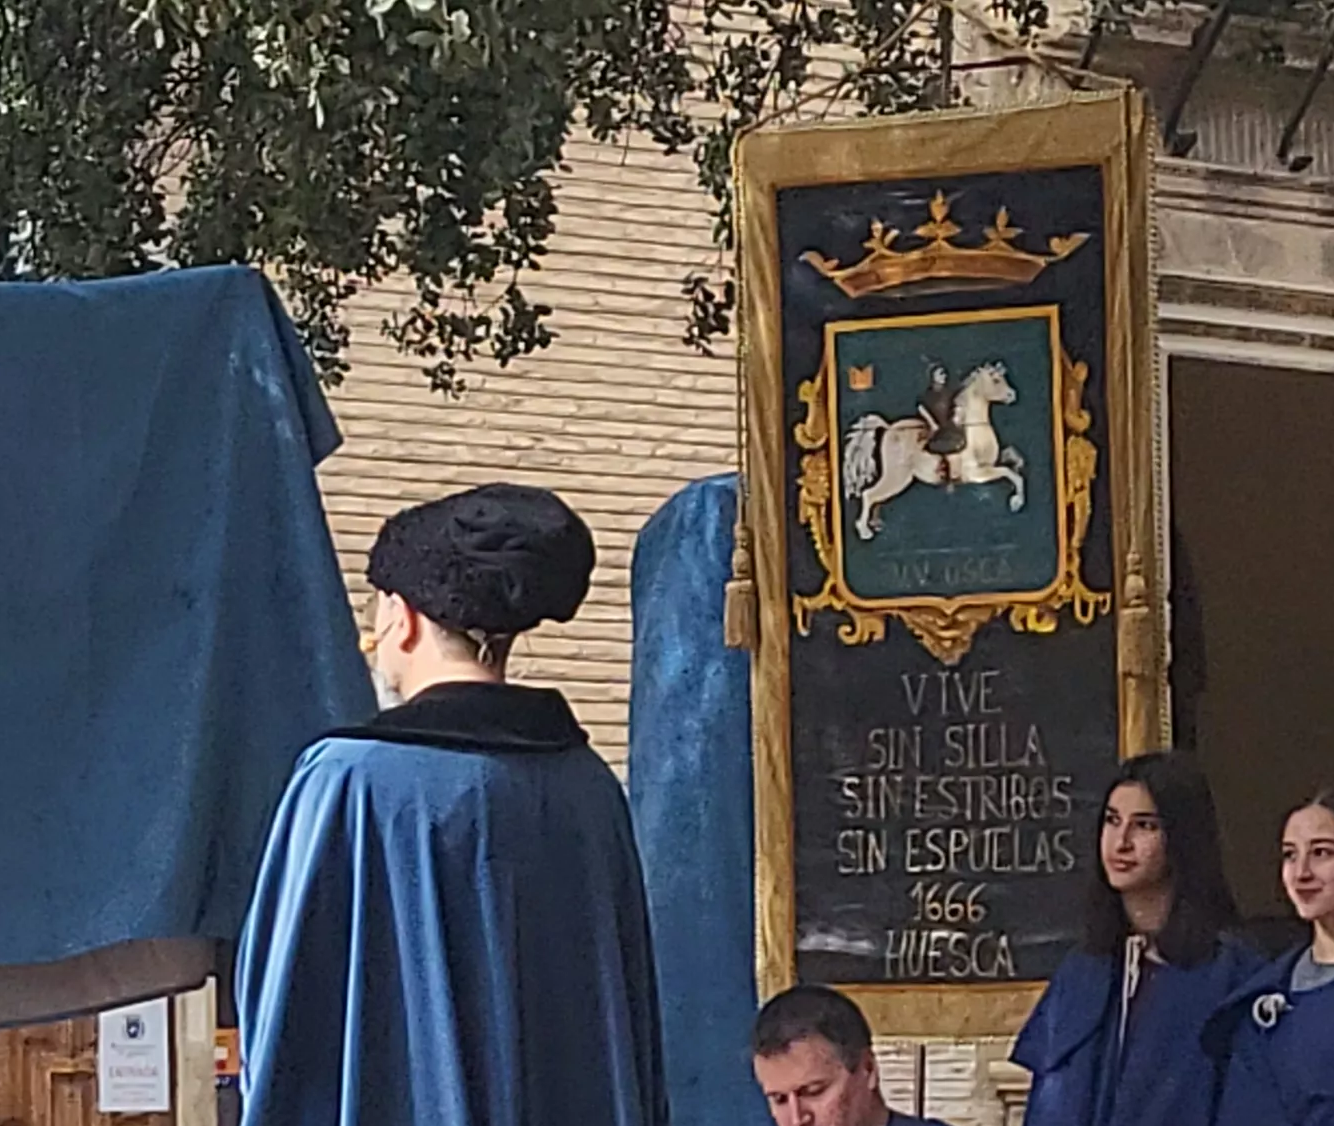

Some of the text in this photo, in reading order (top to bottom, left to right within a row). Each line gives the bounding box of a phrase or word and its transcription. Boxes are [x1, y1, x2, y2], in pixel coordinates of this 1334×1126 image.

[901, 671, 1003, 715] VIVE
[869, 724, 1046, 770] SIN SILLA
[841, 774, 1073, 821] SIN ESTRIBOS
[837, 827, 1076, 874] SIN ESPUELAS
[909, 881, 988, 922] 1666
[884, 929, 1016, 978] HUESCA
